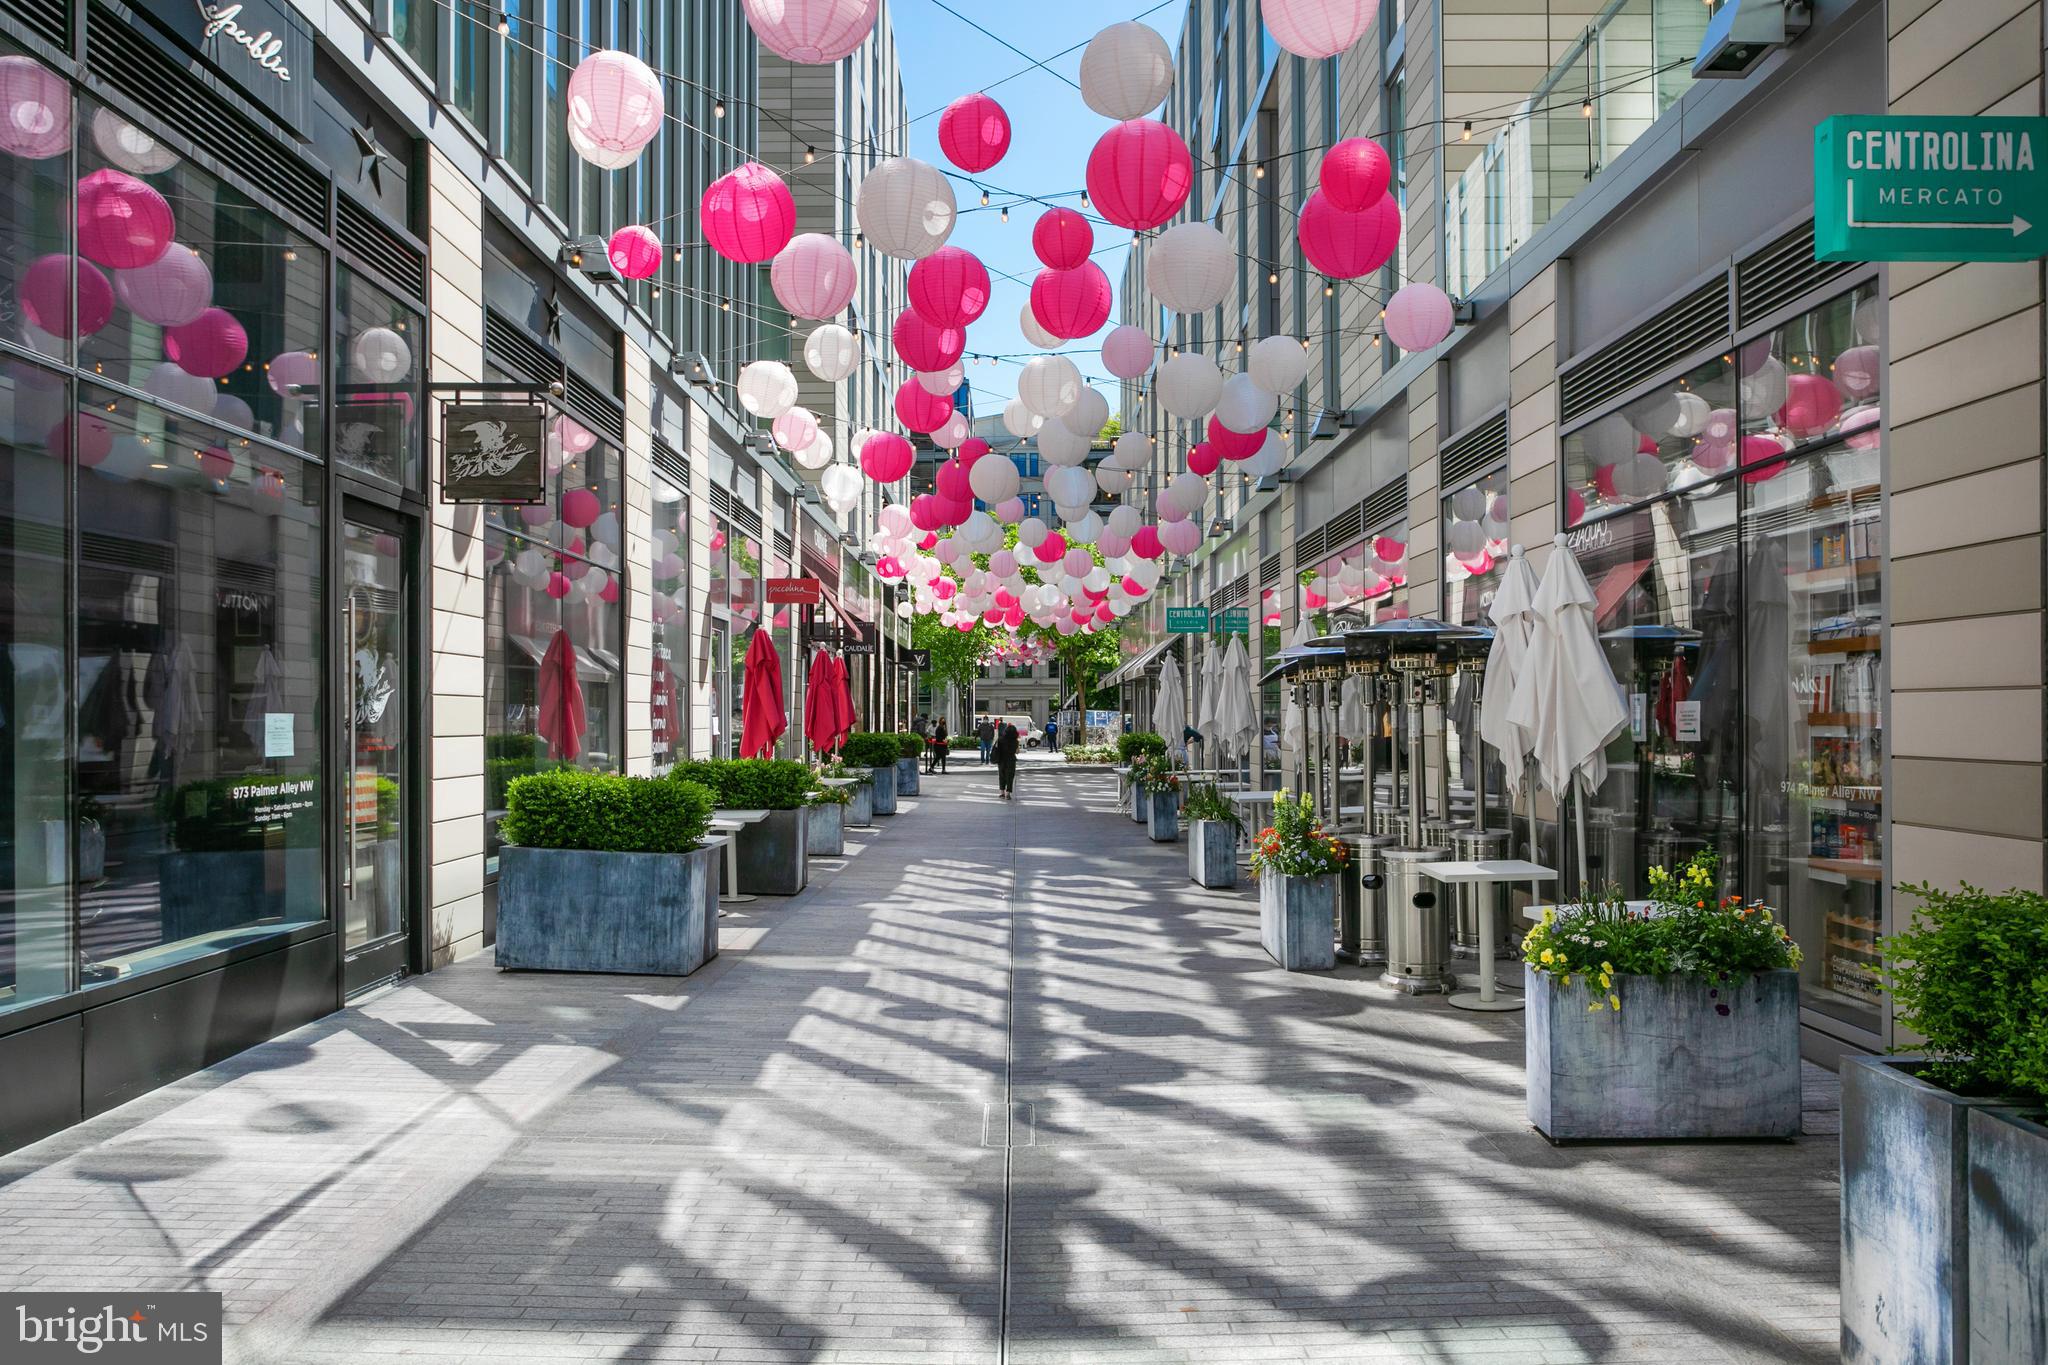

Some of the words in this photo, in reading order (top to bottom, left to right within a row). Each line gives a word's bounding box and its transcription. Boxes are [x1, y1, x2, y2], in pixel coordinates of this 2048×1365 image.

[1847, 130, 2035, 171] CENTROLINA
[1879, 187, 2003, 205] MERCATO
[1169, 610, 1206, 618] CENTROLINA
[233, 786, 249, 799] 973
[251, 784, 278, 797] Palmer
[280, 781, 299, 795] Alley
[300, 780, 314, 792] NW
[1780, 781, 1796, 793] 974
[1798, 782, 1829, 797] Palmer
[1831, 784, 1856, 801] Alley
[1859, 787, 1877, 800] NW
